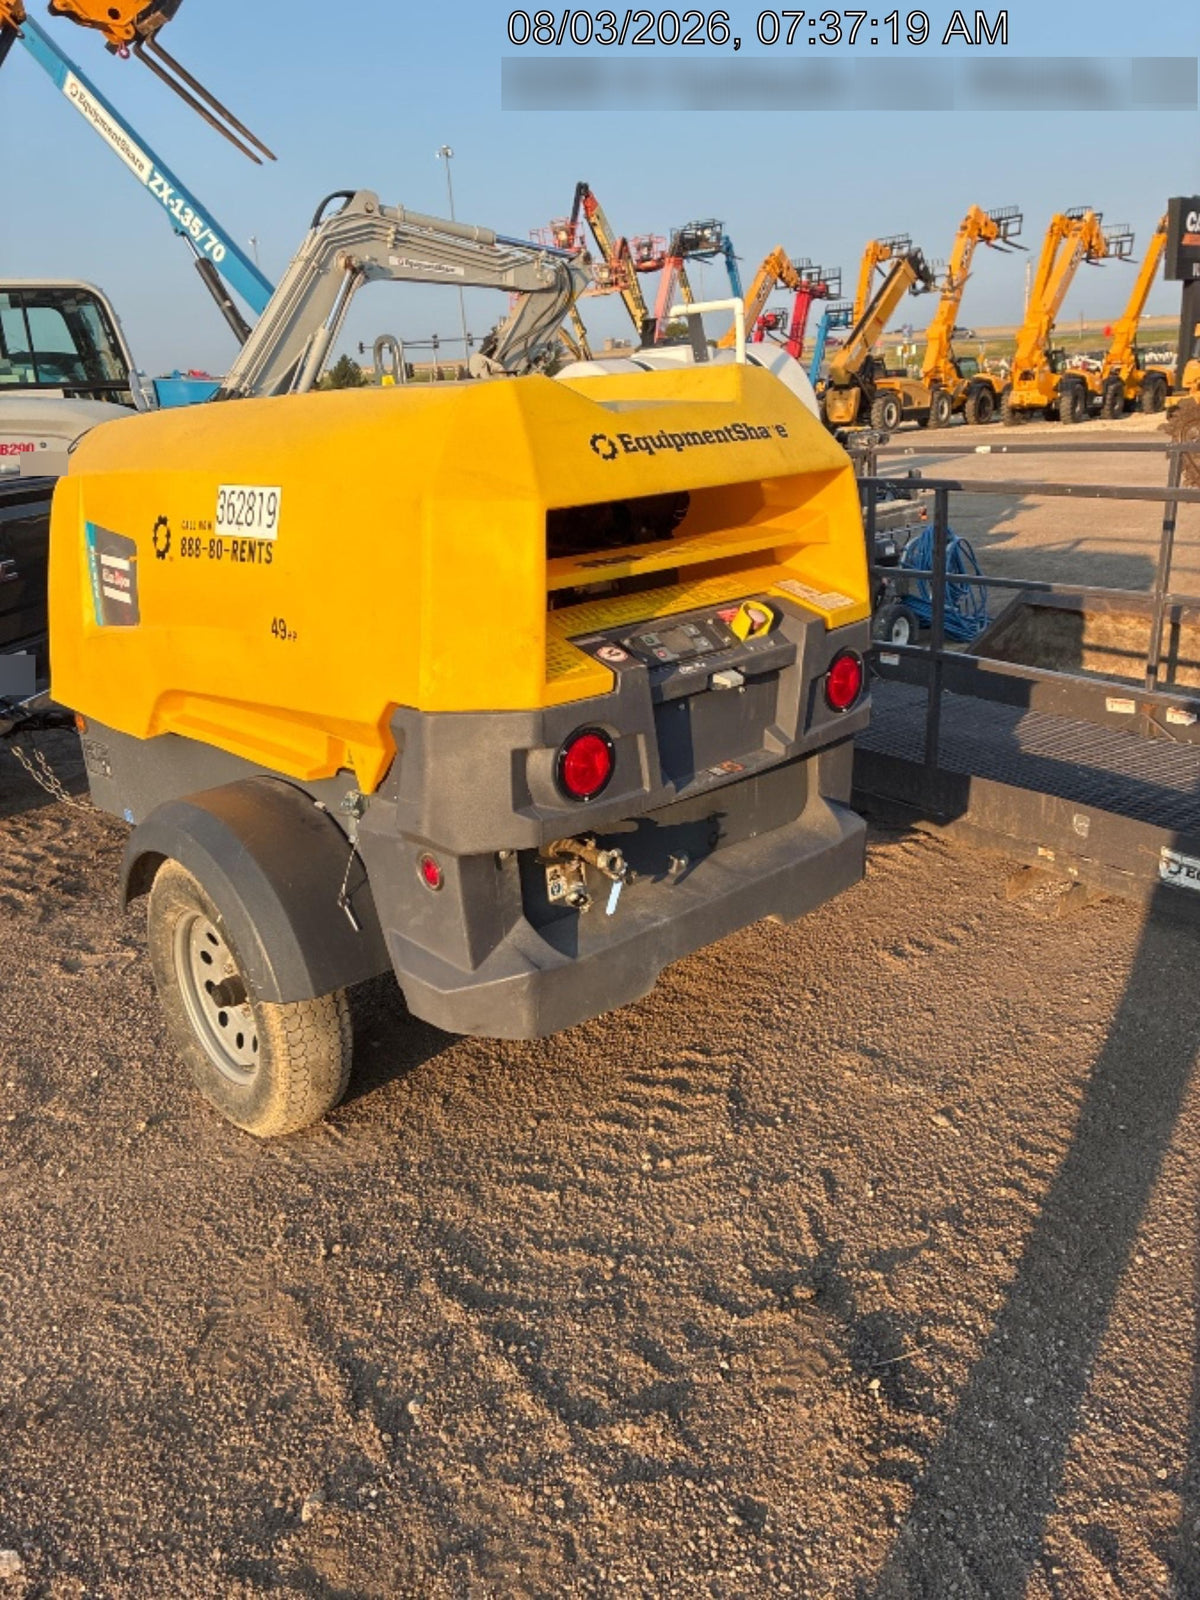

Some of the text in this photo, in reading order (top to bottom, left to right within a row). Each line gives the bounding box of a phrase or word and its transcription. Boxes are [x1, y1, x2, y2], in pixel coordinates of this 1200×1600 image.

[149, 171, 226, 262] ZX-135/70
[616, 423, 788, 456] EquipmentShae
[215, 489, 278, 529] 362819
[180, 536, 273, 565] 888-80-RENTS
